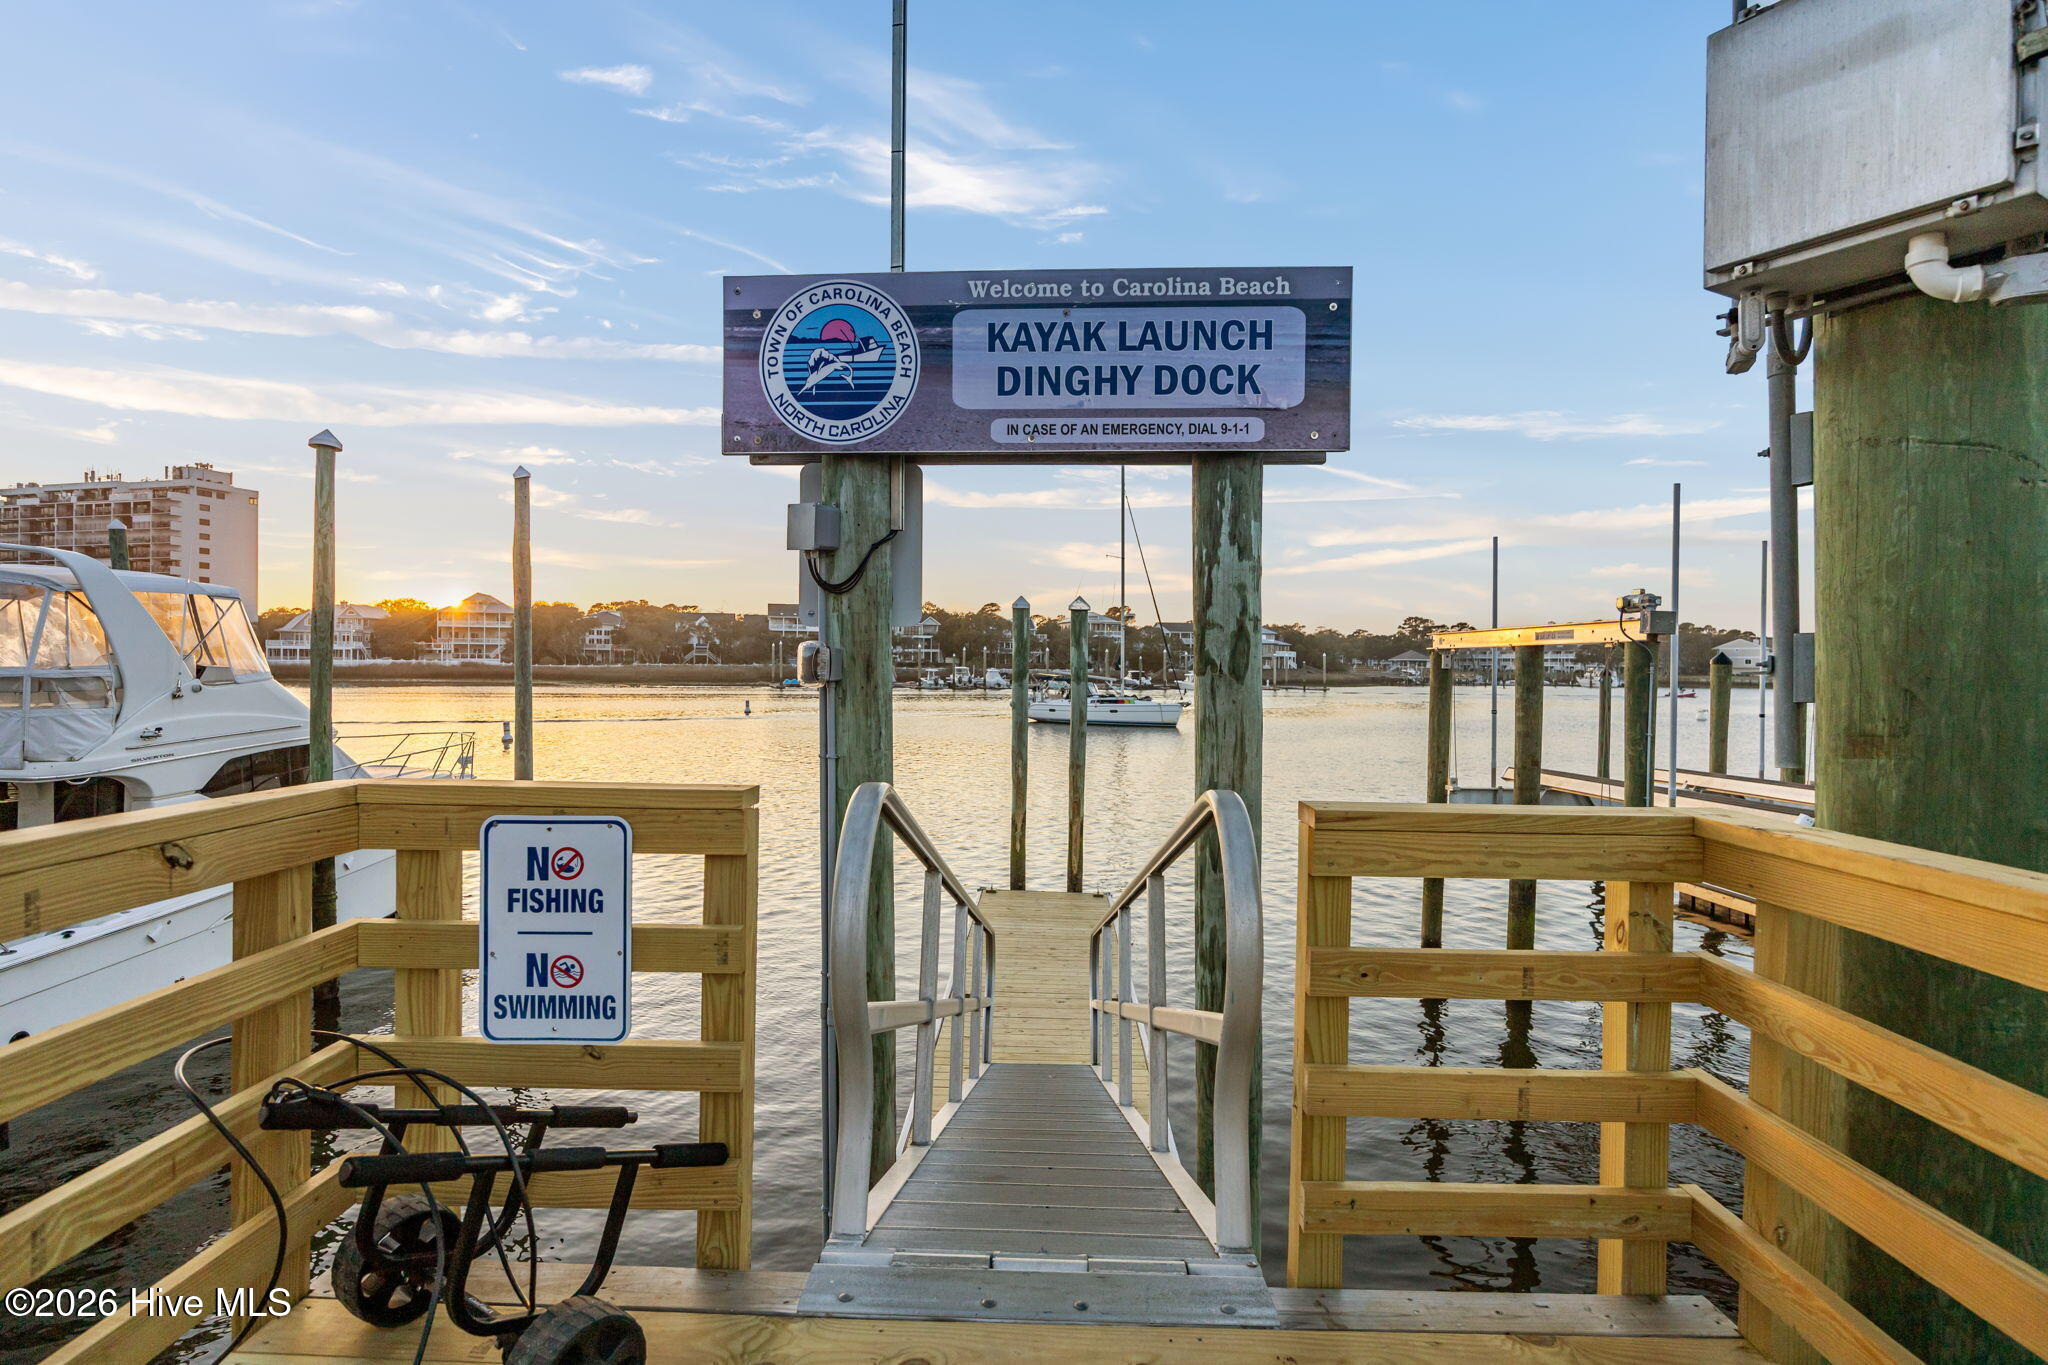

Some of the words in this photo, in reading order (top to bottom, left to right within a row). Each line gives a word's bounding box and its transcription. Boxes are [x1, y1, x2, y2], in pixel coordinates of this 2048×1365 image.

[968, 279, 1072, 298] Welcome
[1080, 280, 1104, 297] to
[1112, 277, 1212, 297] Carolina
[1219, 276, 1291, 296] Beach
[767, 325, 788, 379] TOWN
[785, 301, 805, 322] OF
[808, 287, 892, 320] CAROLINA
[890, 320, 913, 378] BEACH
[987, 320, 1107, 353] KAYAK
[1118, 319, 1273, 351] LAUNCH
[997, 365, 1144, 396] DINGHY
[1154, 364, 1262, 396] DOCK
[774, 393, 826, 436] NORTH
[828, 394, 906, 438] CAROLINA
[1006, 424, 1020, 436] IN
[1022, 423, 1057, 436] CASE
[1060, 423, 1078, 436] OF
[1080, 423, 1099, 435] AN
[1102, 422, 1184, 437] EMERGENCY,
[1188, 422, 1217, 435] DIAL
[1220, 422, 1250, 435] 9-1-1
[507, 888, 604, 913] FISHING
[493, 994, 616, 1020] SWIMMING
